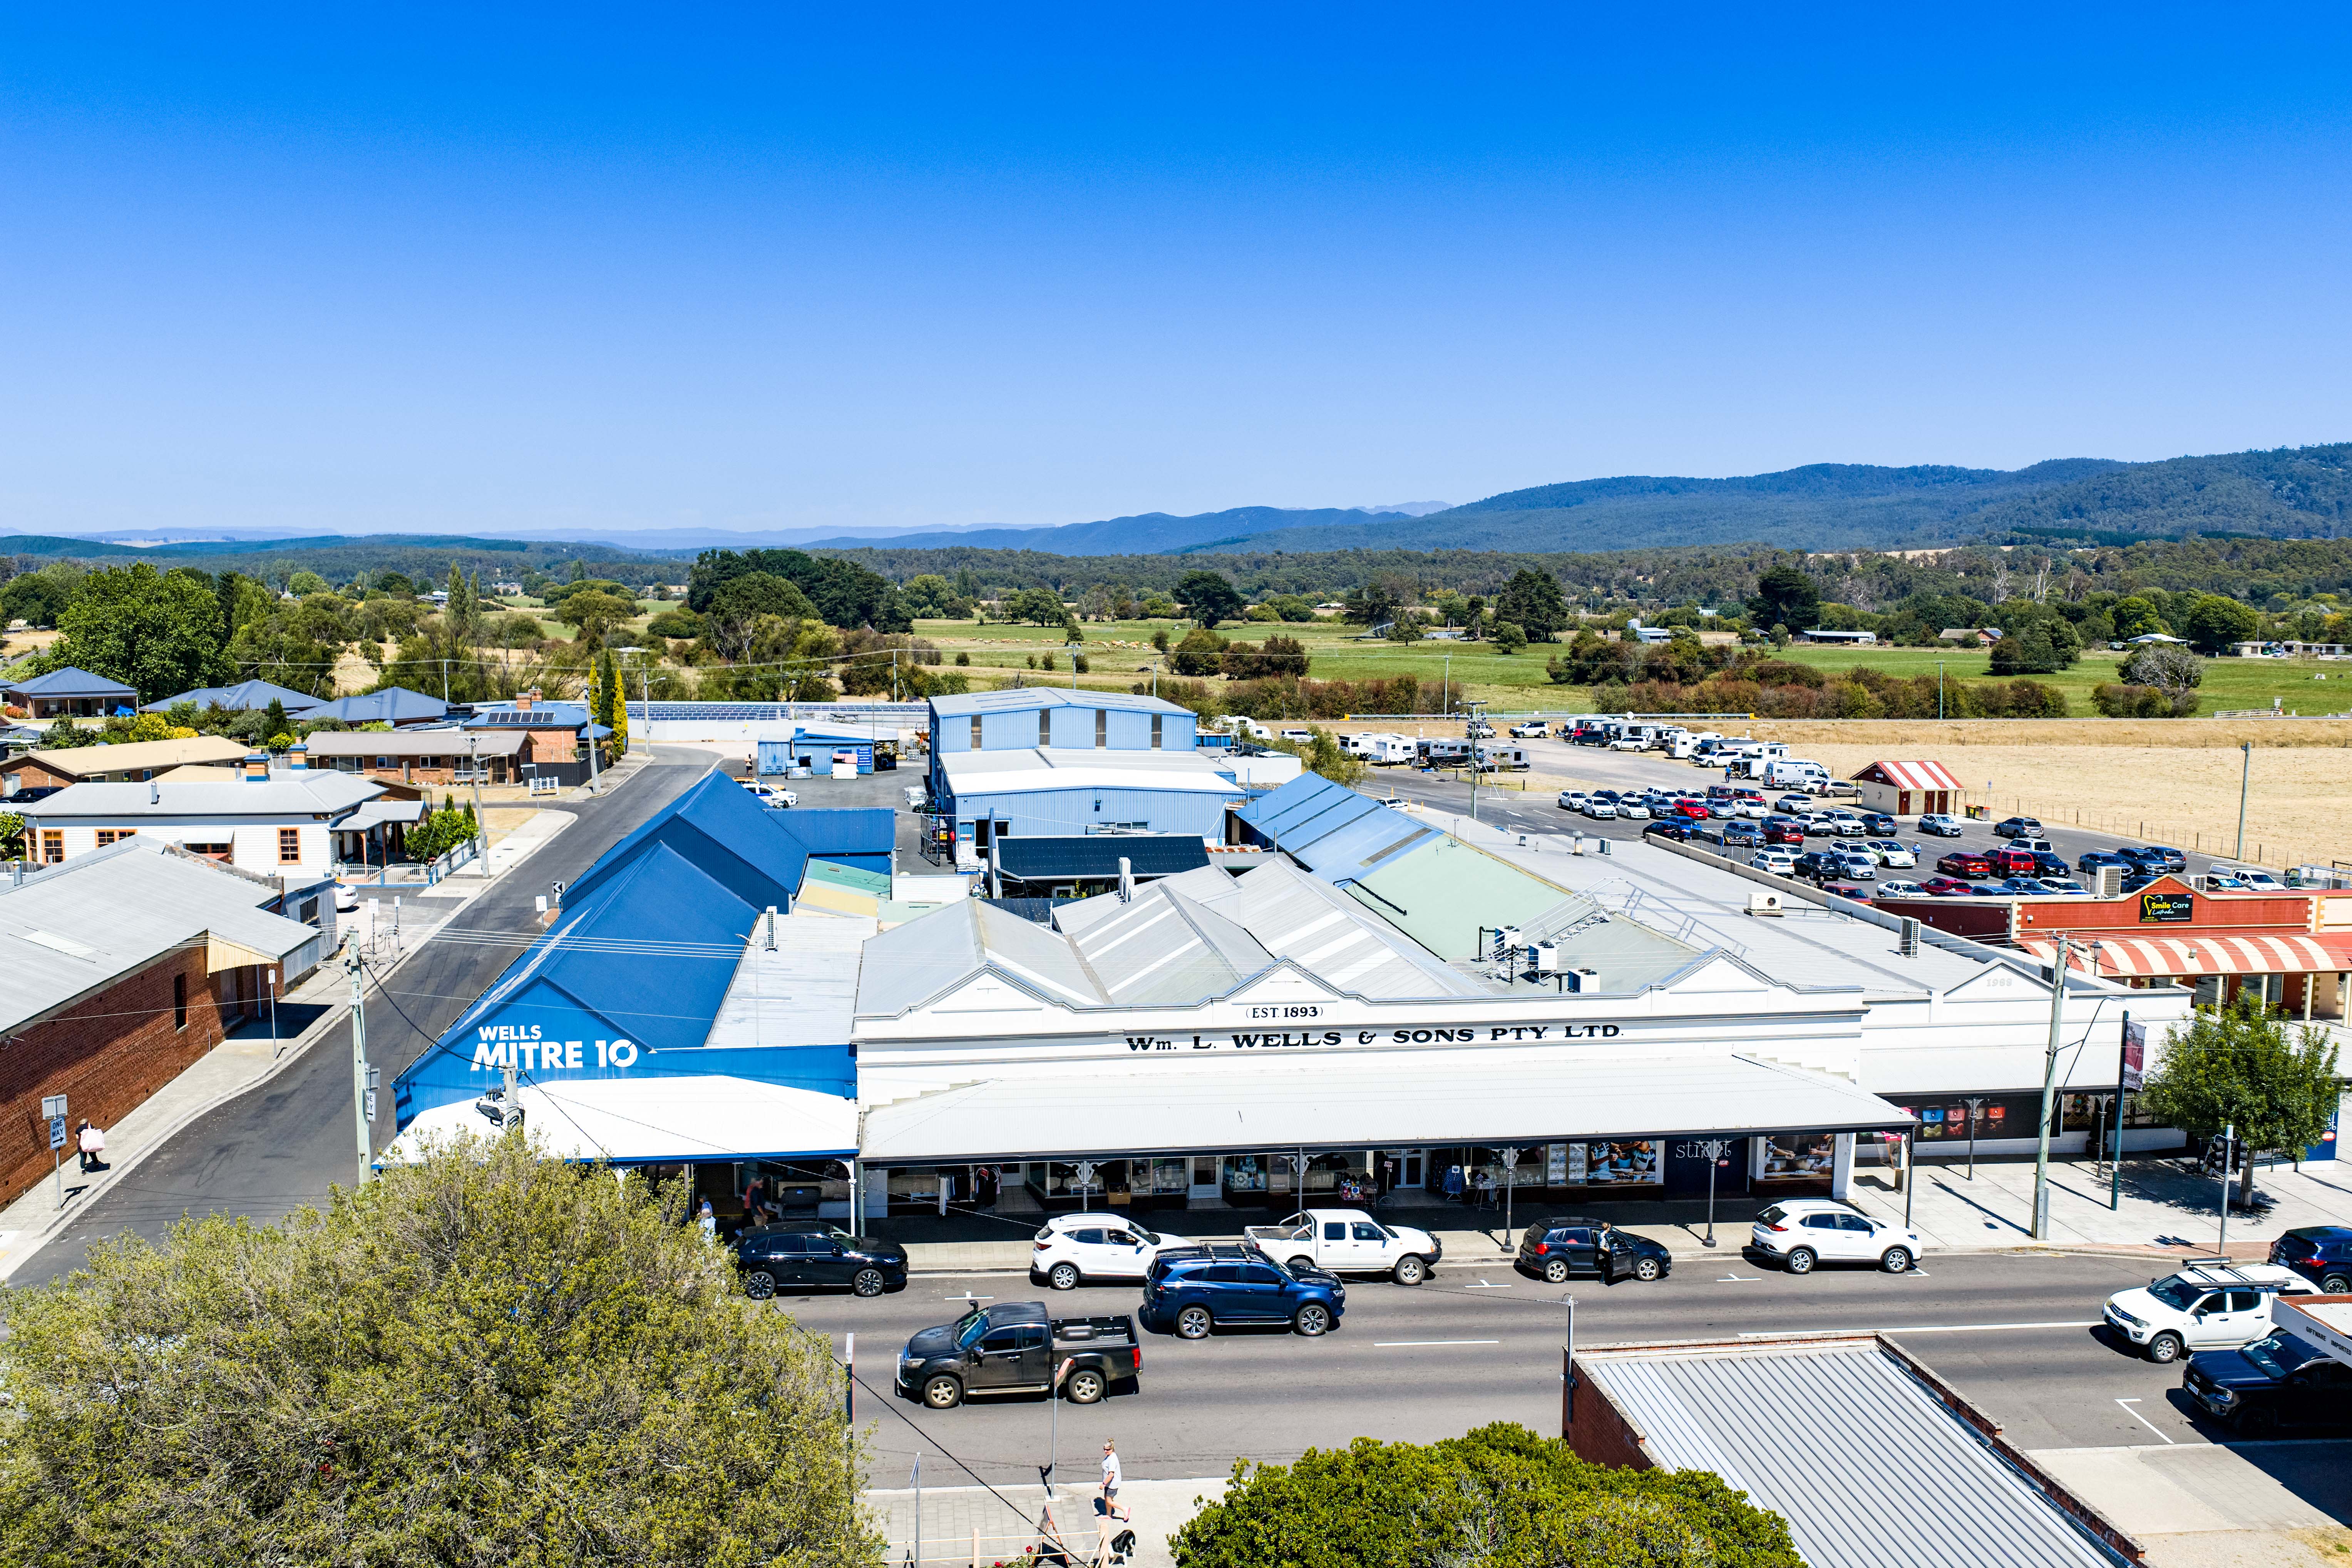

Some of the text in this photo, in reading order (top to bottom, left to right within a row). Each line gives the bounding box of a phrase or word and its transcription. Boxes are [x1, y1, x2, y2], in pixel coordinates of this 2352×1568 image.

[1246, 1008, 1279, 1018] (EST.
[479, 1025, 542, 1041] WELLS
[1126, 1038, 1177, 1051] Wm.
[1193, 1036, 1216, 1049] L.
[1232, 1032, 1341, 1048] WELLS
[1359, 1031, 1376, 1044] &
[1393, 1029, 1474, 1043] SONS
[1565, 1025, 1624, 1038] LTD.
[470, 1039, 638, 1071] MITRE 10
[53, 1120, 63, 1129] ONE
[52, 1128, 64, 1138] WAY
[2306, 1326, 2352, 1355] GIFTWARE IMPORTED
